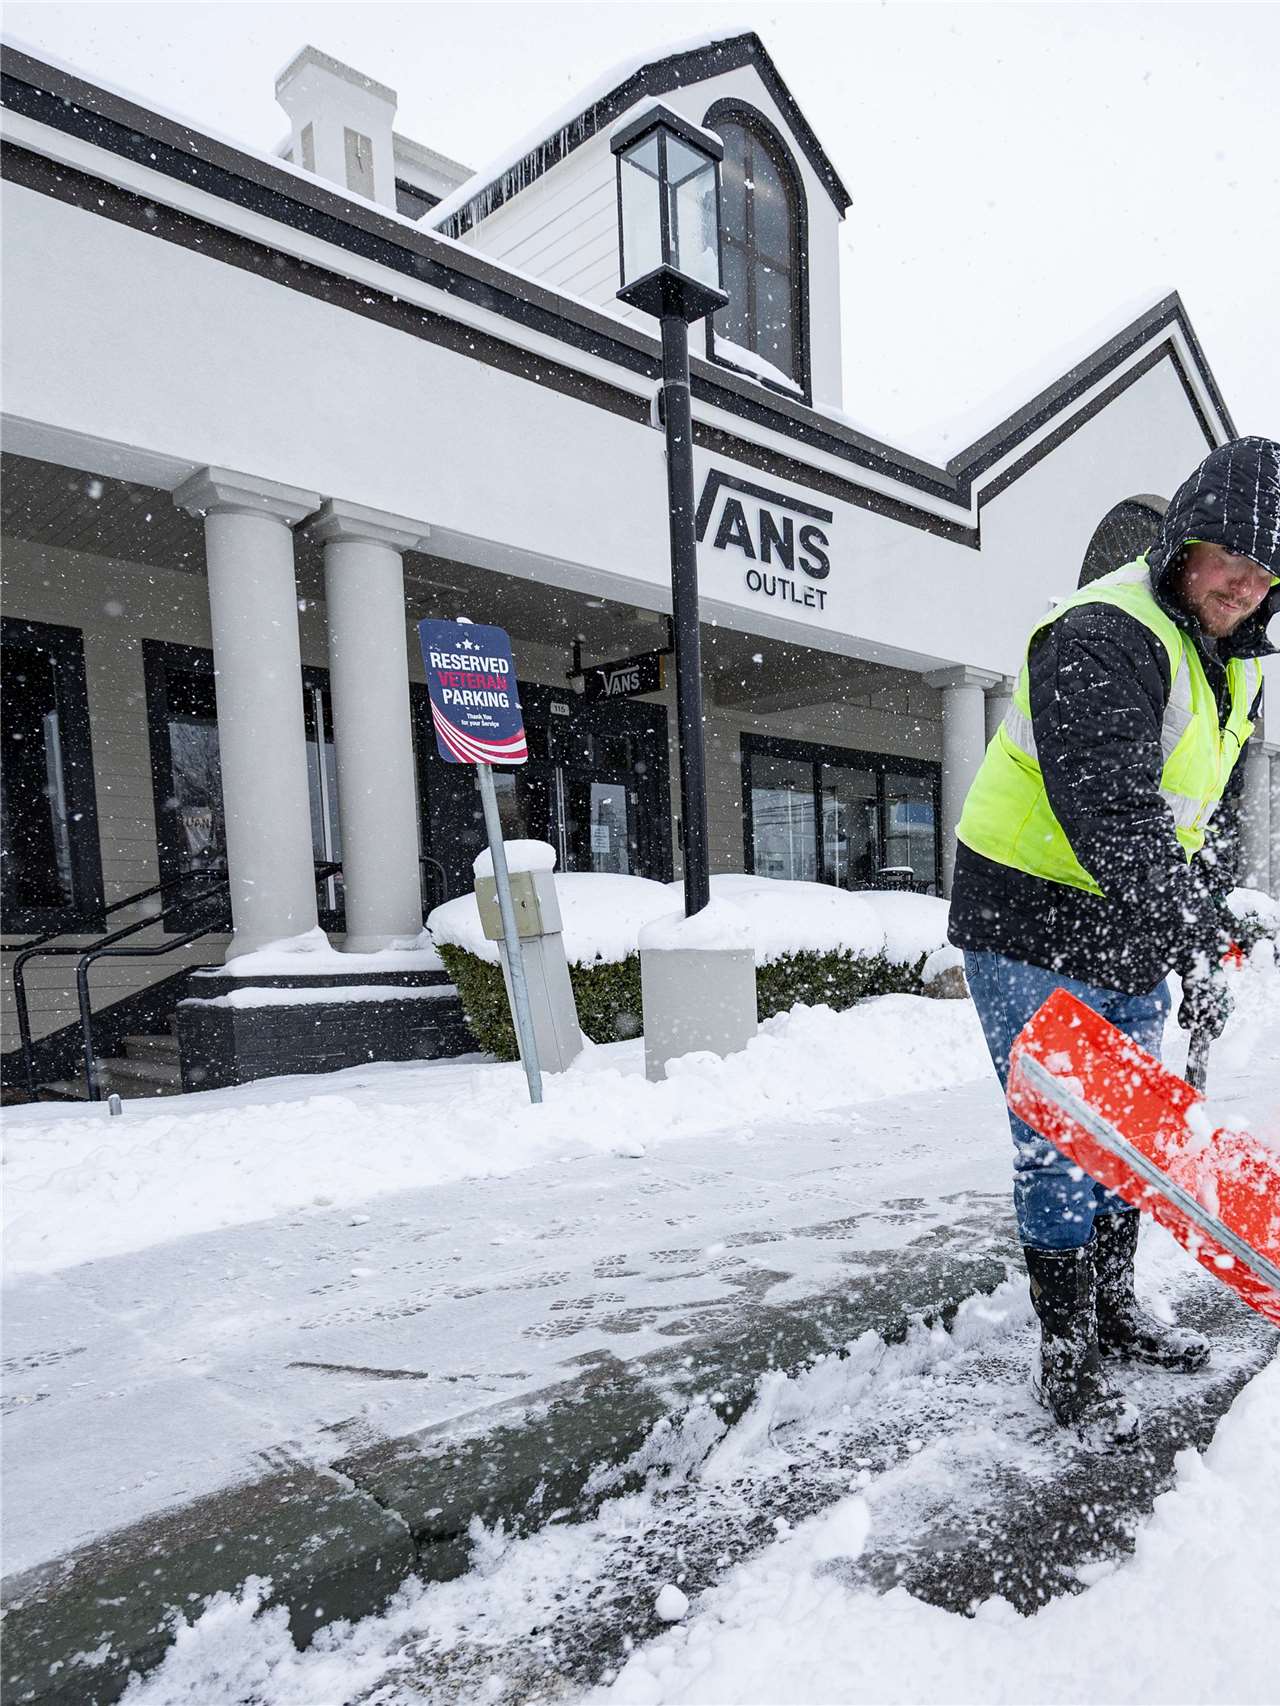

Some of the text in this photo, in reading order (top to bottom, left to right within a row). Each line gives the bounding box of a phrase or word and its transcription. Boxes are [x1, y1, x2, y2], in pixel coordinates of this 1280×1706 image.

[746, 569, 827, 610] OUTLET
[430, 652, 509, 674] RESERVED
[437, 671, 507, 691] VETERAN
[597, 665, 640, 696] VANS
[442, 688, 510, 708] PARKING
